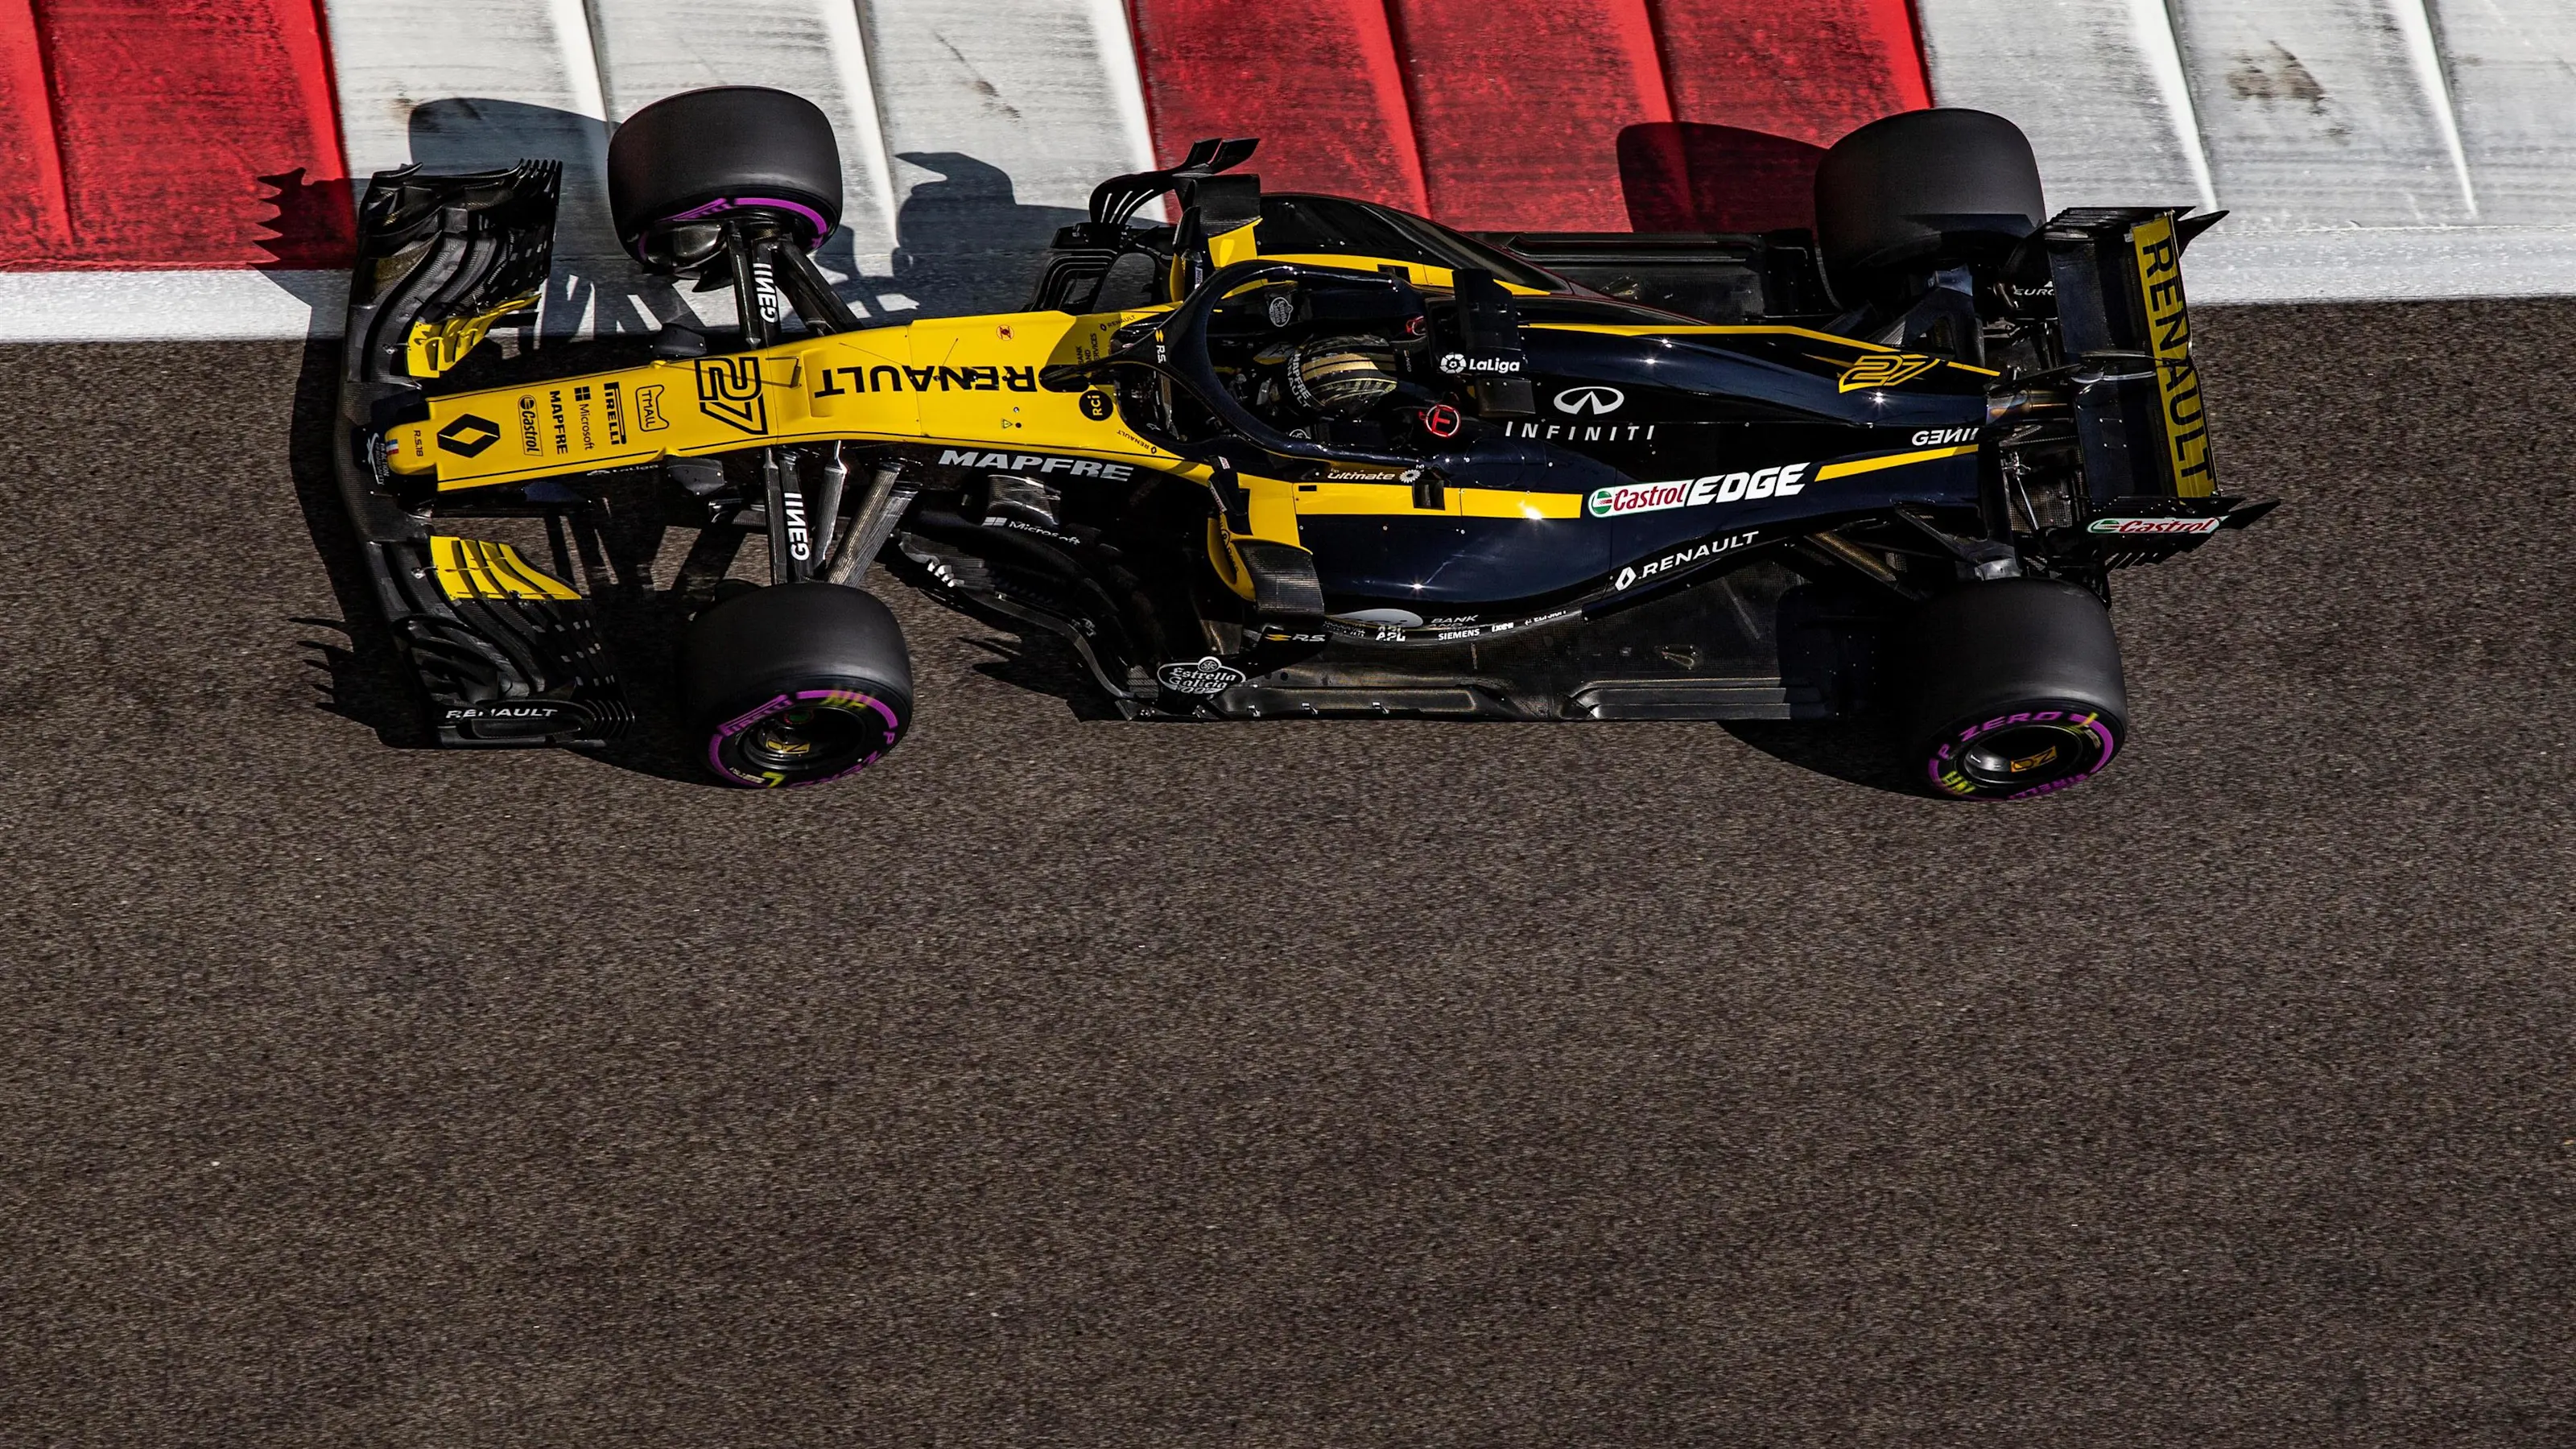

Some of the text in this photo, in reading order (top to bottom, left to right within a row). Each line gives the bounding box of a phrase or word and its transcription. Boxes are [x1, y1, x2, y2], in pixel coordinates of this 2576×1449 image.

[1090, 332, 1100, 360] ERVICES
[2142, 237, 2213, 481] RENAULT
[814, 365, 1038, 398] RENAULT
[1293, 353, 1312, 400] MAPFRE
[1469, 357, 1521, 374] LaLiga
[1839, 354, 1941, 393] 27
[694, 357, 769, 435] 27
[1288, 358, 1312, 408] NAULT
[550, 390, 568, 455] MAPFRE
[604, 382, 627, 445] PIRELLI
[642, 390, 655, 428] TMALL
[522, 410, 540, 452] Castrol
[580, 403, 595, 451] Microsoft
[1117, 430, 1150, 449] RENAULT
[1505, 421, 1654, 441] INFINITI
[414, 430, 423, 457] R.S.18
[938, 450, 1134, 481] MAPFRE
[1328, 469, 1396, 482] ultimate
[1612, 462, 1810, 512] Castrol EDGE
[2120, 518, 2216, 533] Castrol
[1639, 530, 1759, 580] RENAULT
[1430, 615, 1478, 624] BANK
[1438, 629, 1480, 641] SIEMENS
[1168, 676, 1228, 691] Galicia
[1169, 667, 1237, 683] Estrella
[1958, 712, 2063, 741] ZERO
